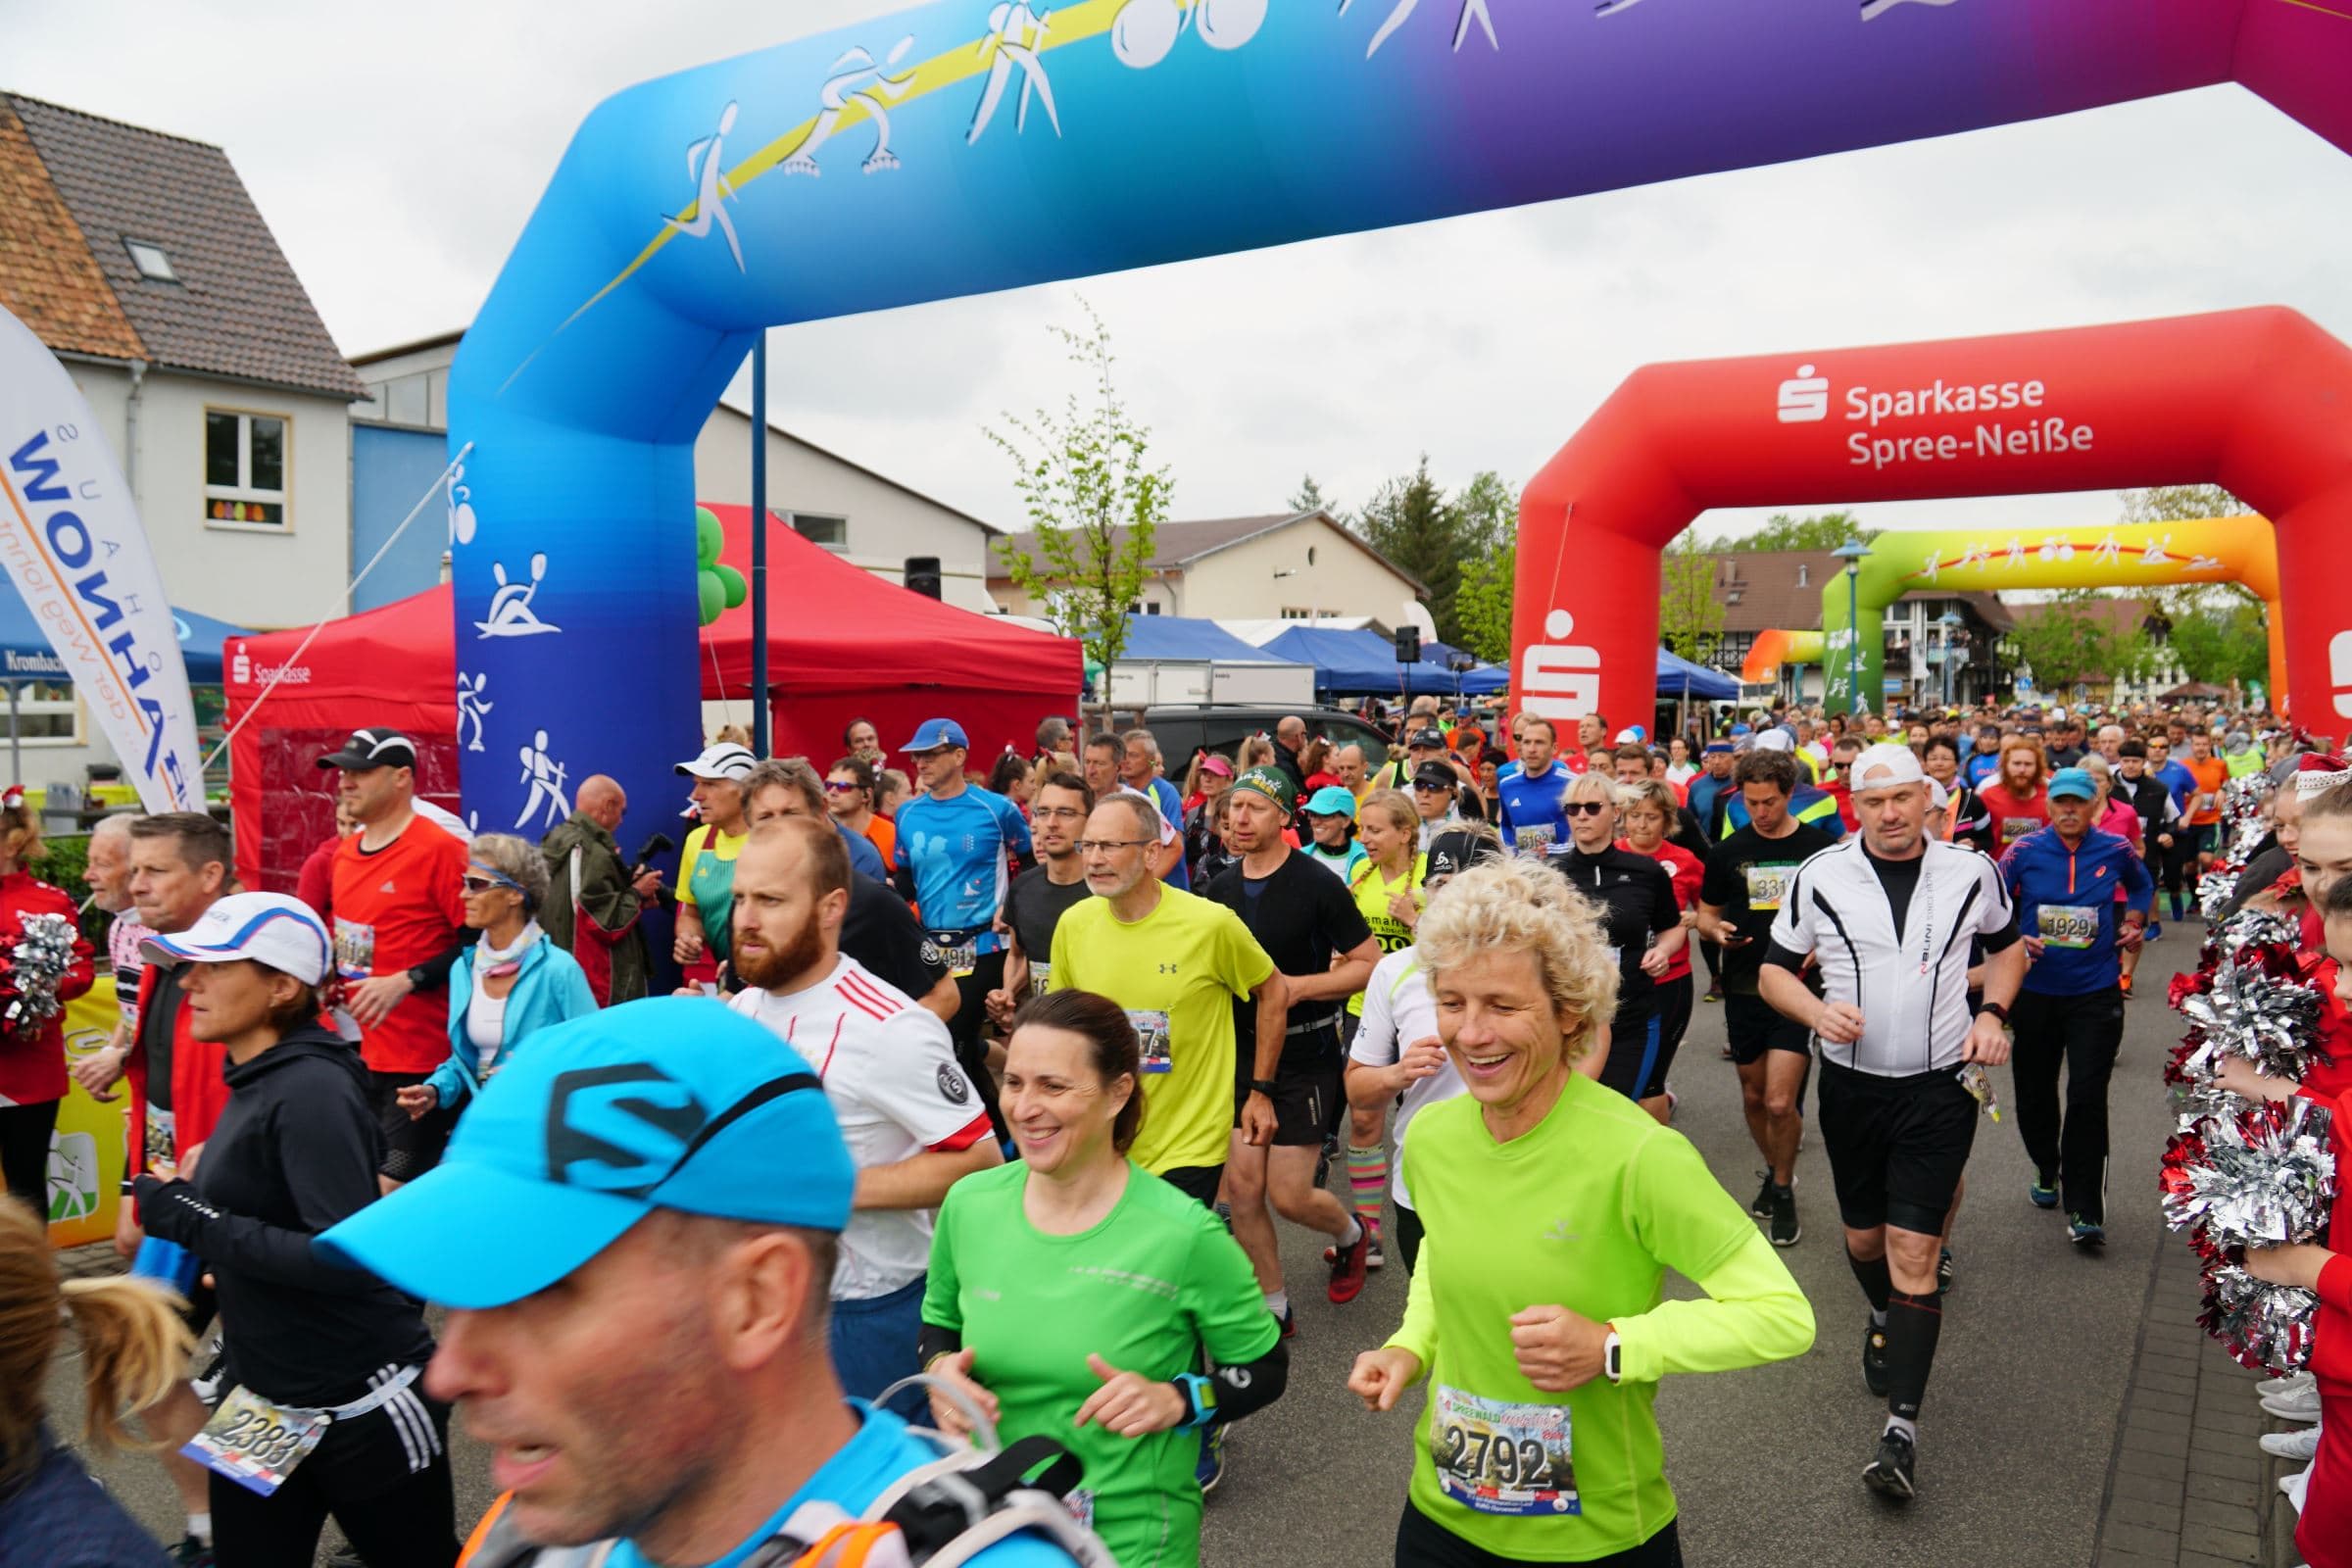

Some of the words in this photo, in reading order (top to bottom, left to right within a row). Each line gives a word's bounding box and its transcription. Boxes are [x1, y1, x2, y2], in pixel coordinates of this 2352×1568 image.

[1844, 379, 2045, 427] Sparkasse
[1846, 416, 2094, 470] Spree-Neiße
[1756, 879, 1792, 901] 331
[2046, 916, 2090, 938] 1929
[936, 947, 967, 966] 491
[1446, 1425, 1553, 1491] 2792
